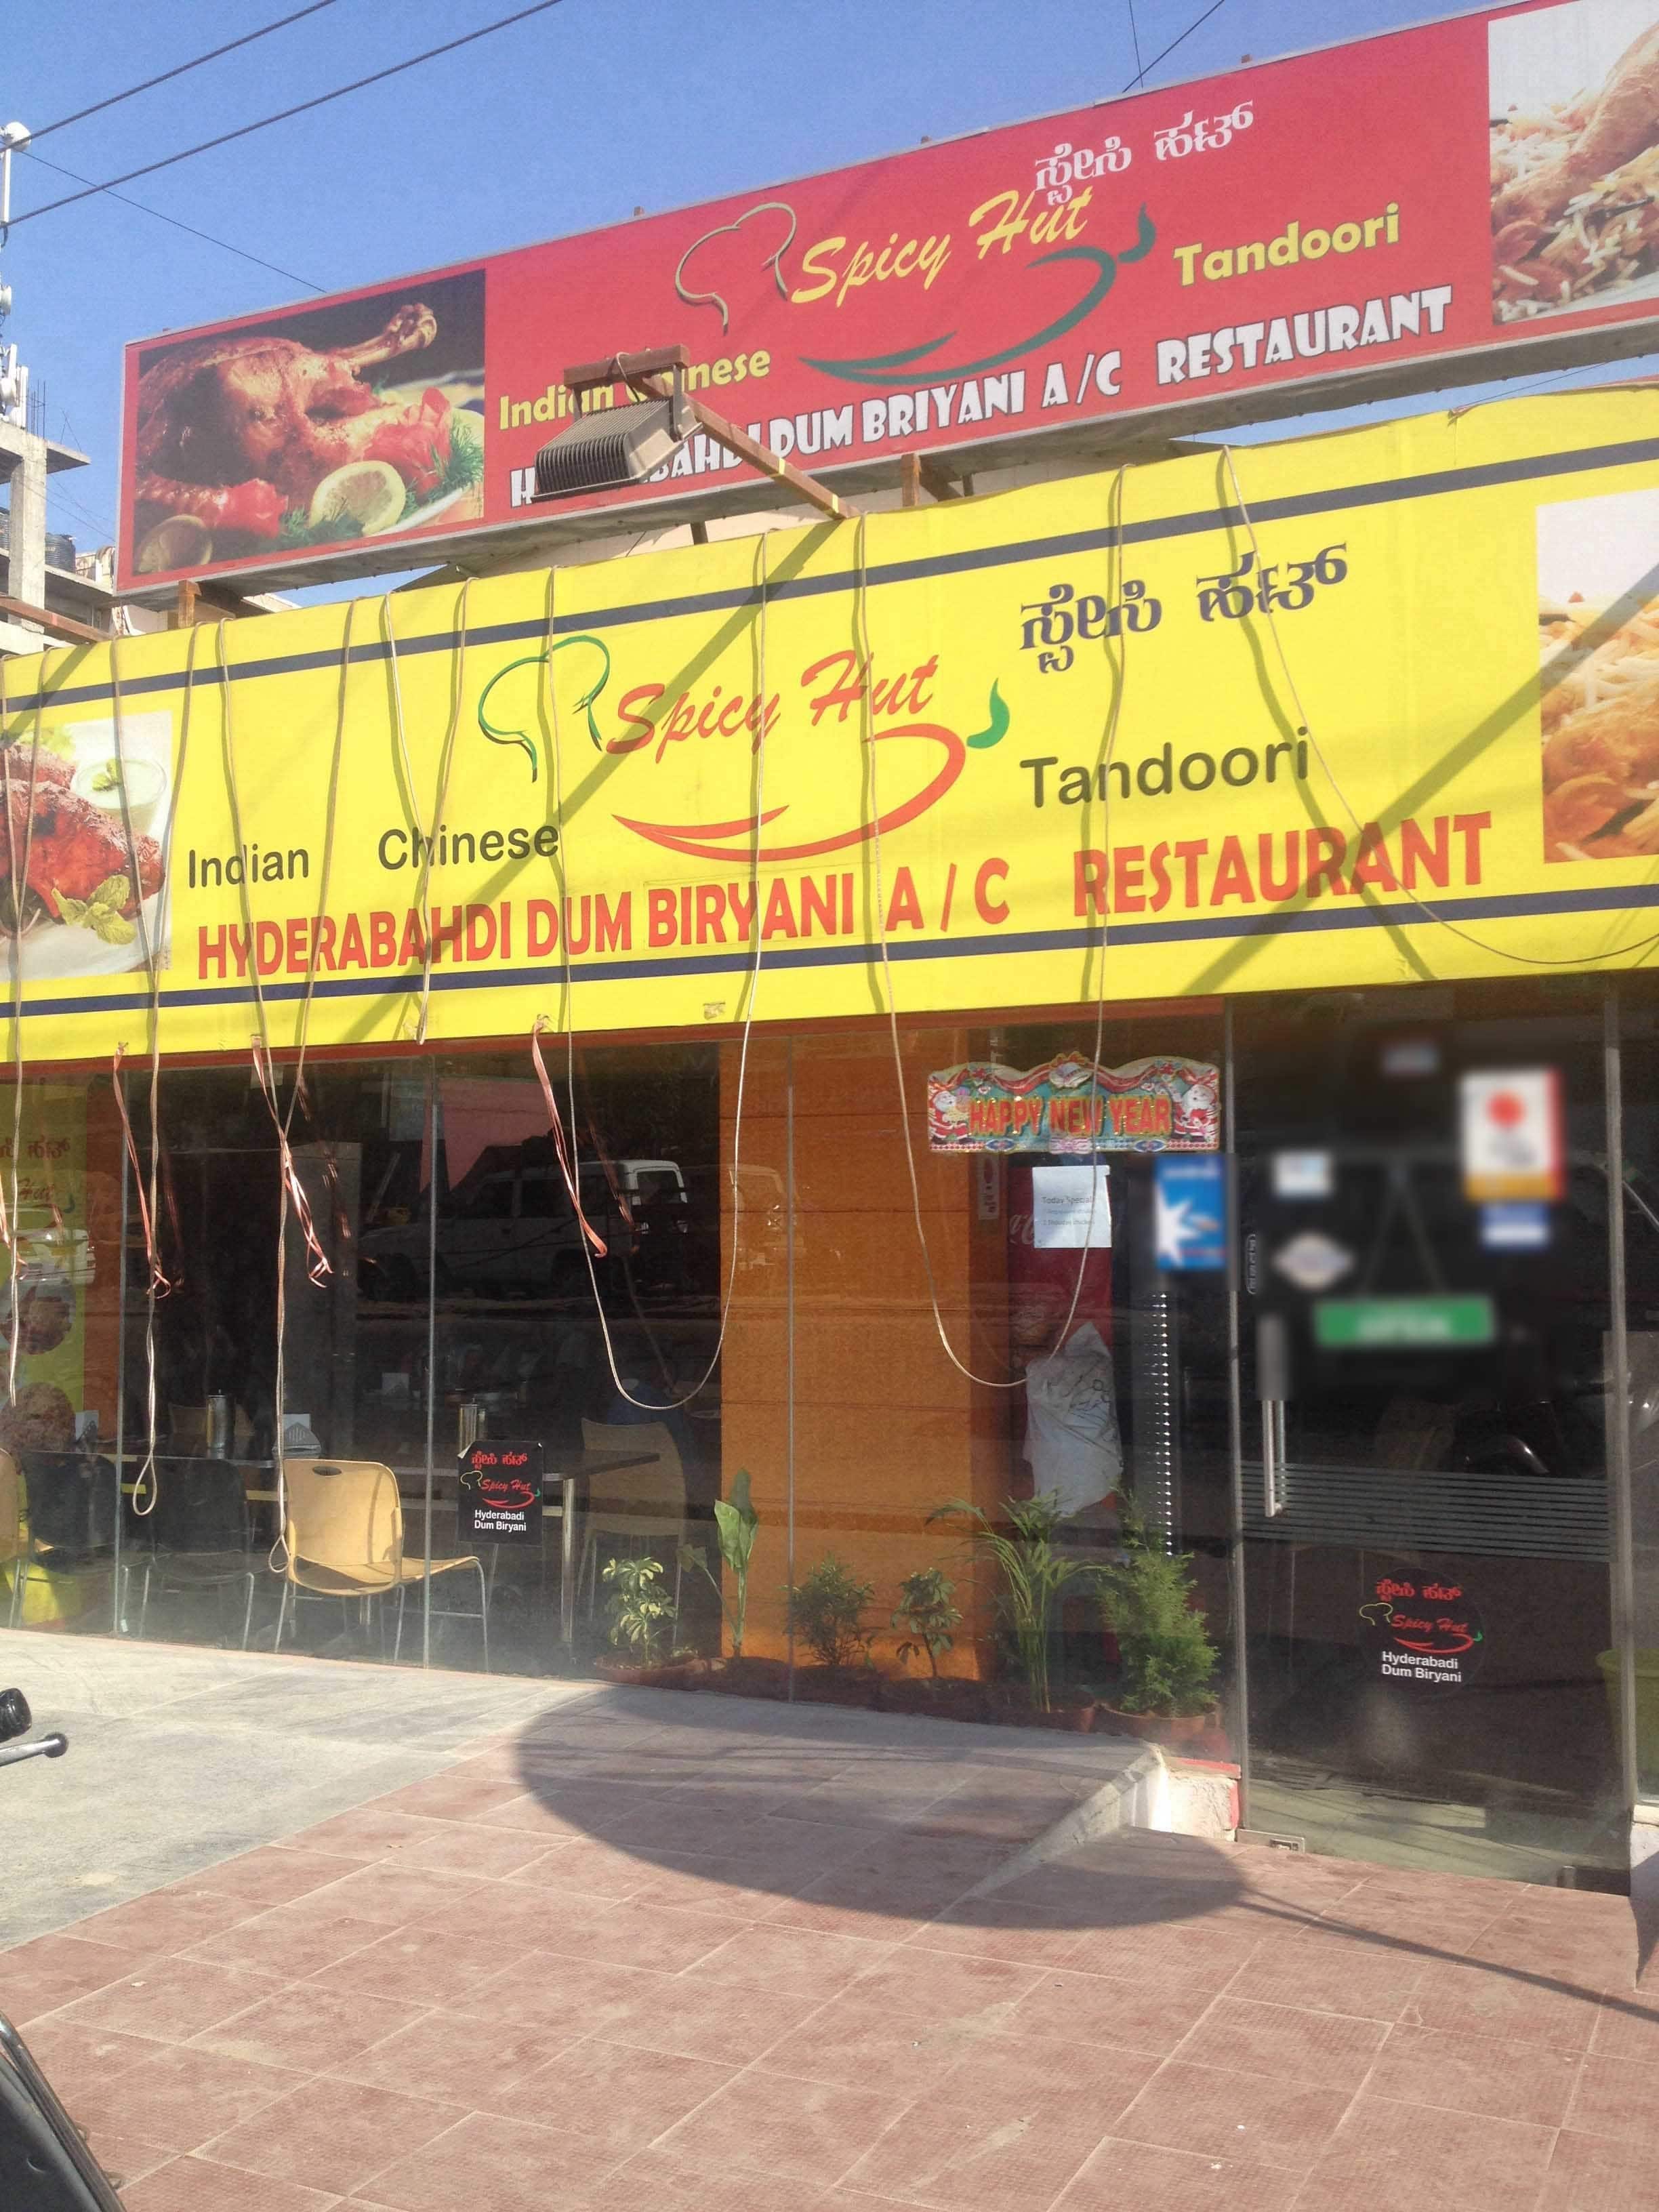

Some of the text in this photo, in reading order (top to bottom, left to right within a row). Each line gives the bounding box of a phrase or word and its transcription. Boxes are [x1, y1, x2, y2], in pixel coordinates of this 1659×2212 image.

[791, 186, 1093, 308] Spicy Hut
[1172, 202, 1400, 287] Tandoori
[769, 404, 854, 459] DUM
[862, 370, 1025, 443] BRIYANI
[1157, 284, 1453, 386] RESTAURANT
[499, 384, 615, 430] Indian
[606, 650, 939, 764] Spicy Hut
[1019, 726, 1309, 808] Tandoori
[188, 824, 559, 888] Indian Chinese
[198, 901, 511, 980] HYDERABAHDI
[527, 890, 632, 958] DUM
[647, 872, 855, 948] BIRYANI
[1073, 811, 1492, 917] RESTAURANT
[968, 1095, 1172, 1136] HAPPY NEW YEAR
[480, 1479, 531, 1492] Spicy Hut
[474, 1509, 525, 1521] Hyderabadi
[474, 1520, 527, 1532] Dum Biryani
[1391, 1614, 1469, 1633] Spicy Hut
[1382, 1651, 1459, 1669] Hyderabadi
[1382, 1664, 1462, 1683] Dum Biryani
